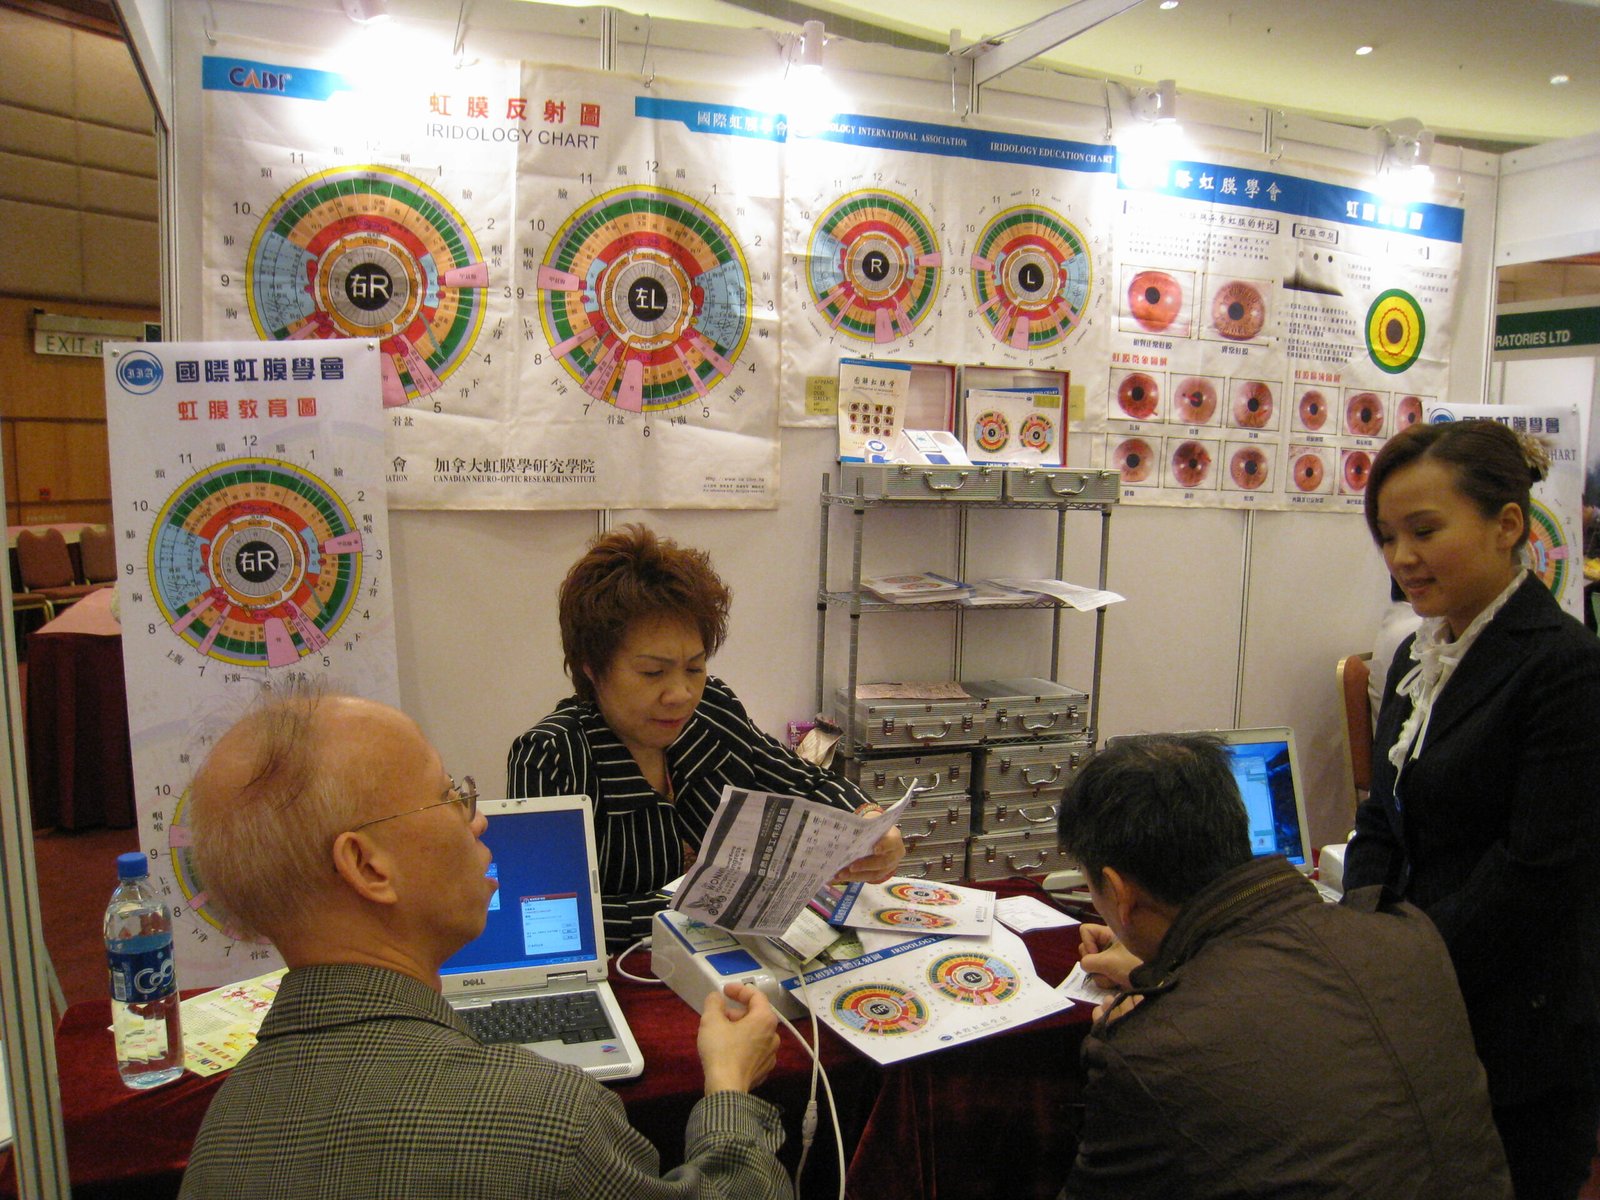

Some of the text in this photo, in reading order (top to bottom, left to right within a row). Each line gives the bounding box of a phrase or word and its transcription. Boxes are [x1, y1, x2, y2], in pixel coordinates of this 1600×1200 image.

[429, 92, 600, 127] 虹膜反射圖
[427, 123, 600, 149] IRIDOLOGY CHART
[858, 125, 918, 142] INTERNATIONAL
[921, 133, 968, 148] ASSOCIATION
[290, 152, 304, 164] 11
[990, 142, 1114, 165] IRIDOLOGY EDUCATION CHART
[437, 165, 442, 177] 1
[645, 160, 660, 173] 12
[579, 172, 593, 185] 11
[873, 172, 882, 181] 12
[712, 184, 718, 195] 1
[1031, 188, 1040, 197] 12
[992, 195, 1001, 204] 11
[233, 202, 251, 216] 10
[487, 218, 495, 230] 2
[529, 219, 546, 232] 10
[941, 223, 946, 232] 2
[966, 224, 976, 233] 10
[754, 235, 762, 247] 2
[792, 256, 798, 265] 9
[870, 258, 882, 273] R
[958, 267, 964, 276] 9
[1027, 270, 1035, 284] L
[221, 273, 230, 287] 9
[504, 286, 512, 299] 3
[516, 287, 525, 299] 9
[634, 287, 666, 310] 左L
[767, 300, 774, 311] 3
[801, 301, 807, 310] 8
[937, 310, 943, 318] 4
[968, 310, 973, 318] 8
[1087, 318, 1093, 326] 4
[46, 335, 86, 353] EXIT
[908, 339, 914, 348] 5
[1495, 330, 1571, 347] RATORIES LTD
[483, 353, 491, 365] 4
[534, 353, 542, 366] 8
[1028, 358, 1034, 367] 6
[175, 356, 345, 384] 國際虹膜學會
[748, 362, 756, 374] 4
[177, 397, 317, 422] 虹膜教育圖
[433, 401, 442, 414] 5
[582, 403, 590, 416] 7
[702, 406, 710, 419] 5
[643, 425, 651, 438] 6
[242, 435, 258, 447] 12
[179, 453, 192, 464] 11
[310, 449, 315, 460] 1
[1549, 449, 1577, 461] HART
[392, 456, 408, 473] 會
[433, 475, 597, 483] CANADIAN NEURO-OPTIC RESEARCH INSTITUTE
[358, 490, 365, 502] 2
[133, 500, 148, 512] 10
[376, 549, 383, 561] 3
[238, 550, 277, 573] 右R
[126, 563, 134, 575] 9
[363, 609, 371, 620] 4
[148, 623, 156, 635] 8
[323, 655, 330, 667] 5
[198, 665, 206, 677] 7
[154, 784, 171, 796] 10
[150, 849, 158, 860] 9
[173, 906, 182, 918] 8
[224, 945, 232, 957] 7
[462, 978, 486, 987] DELL
